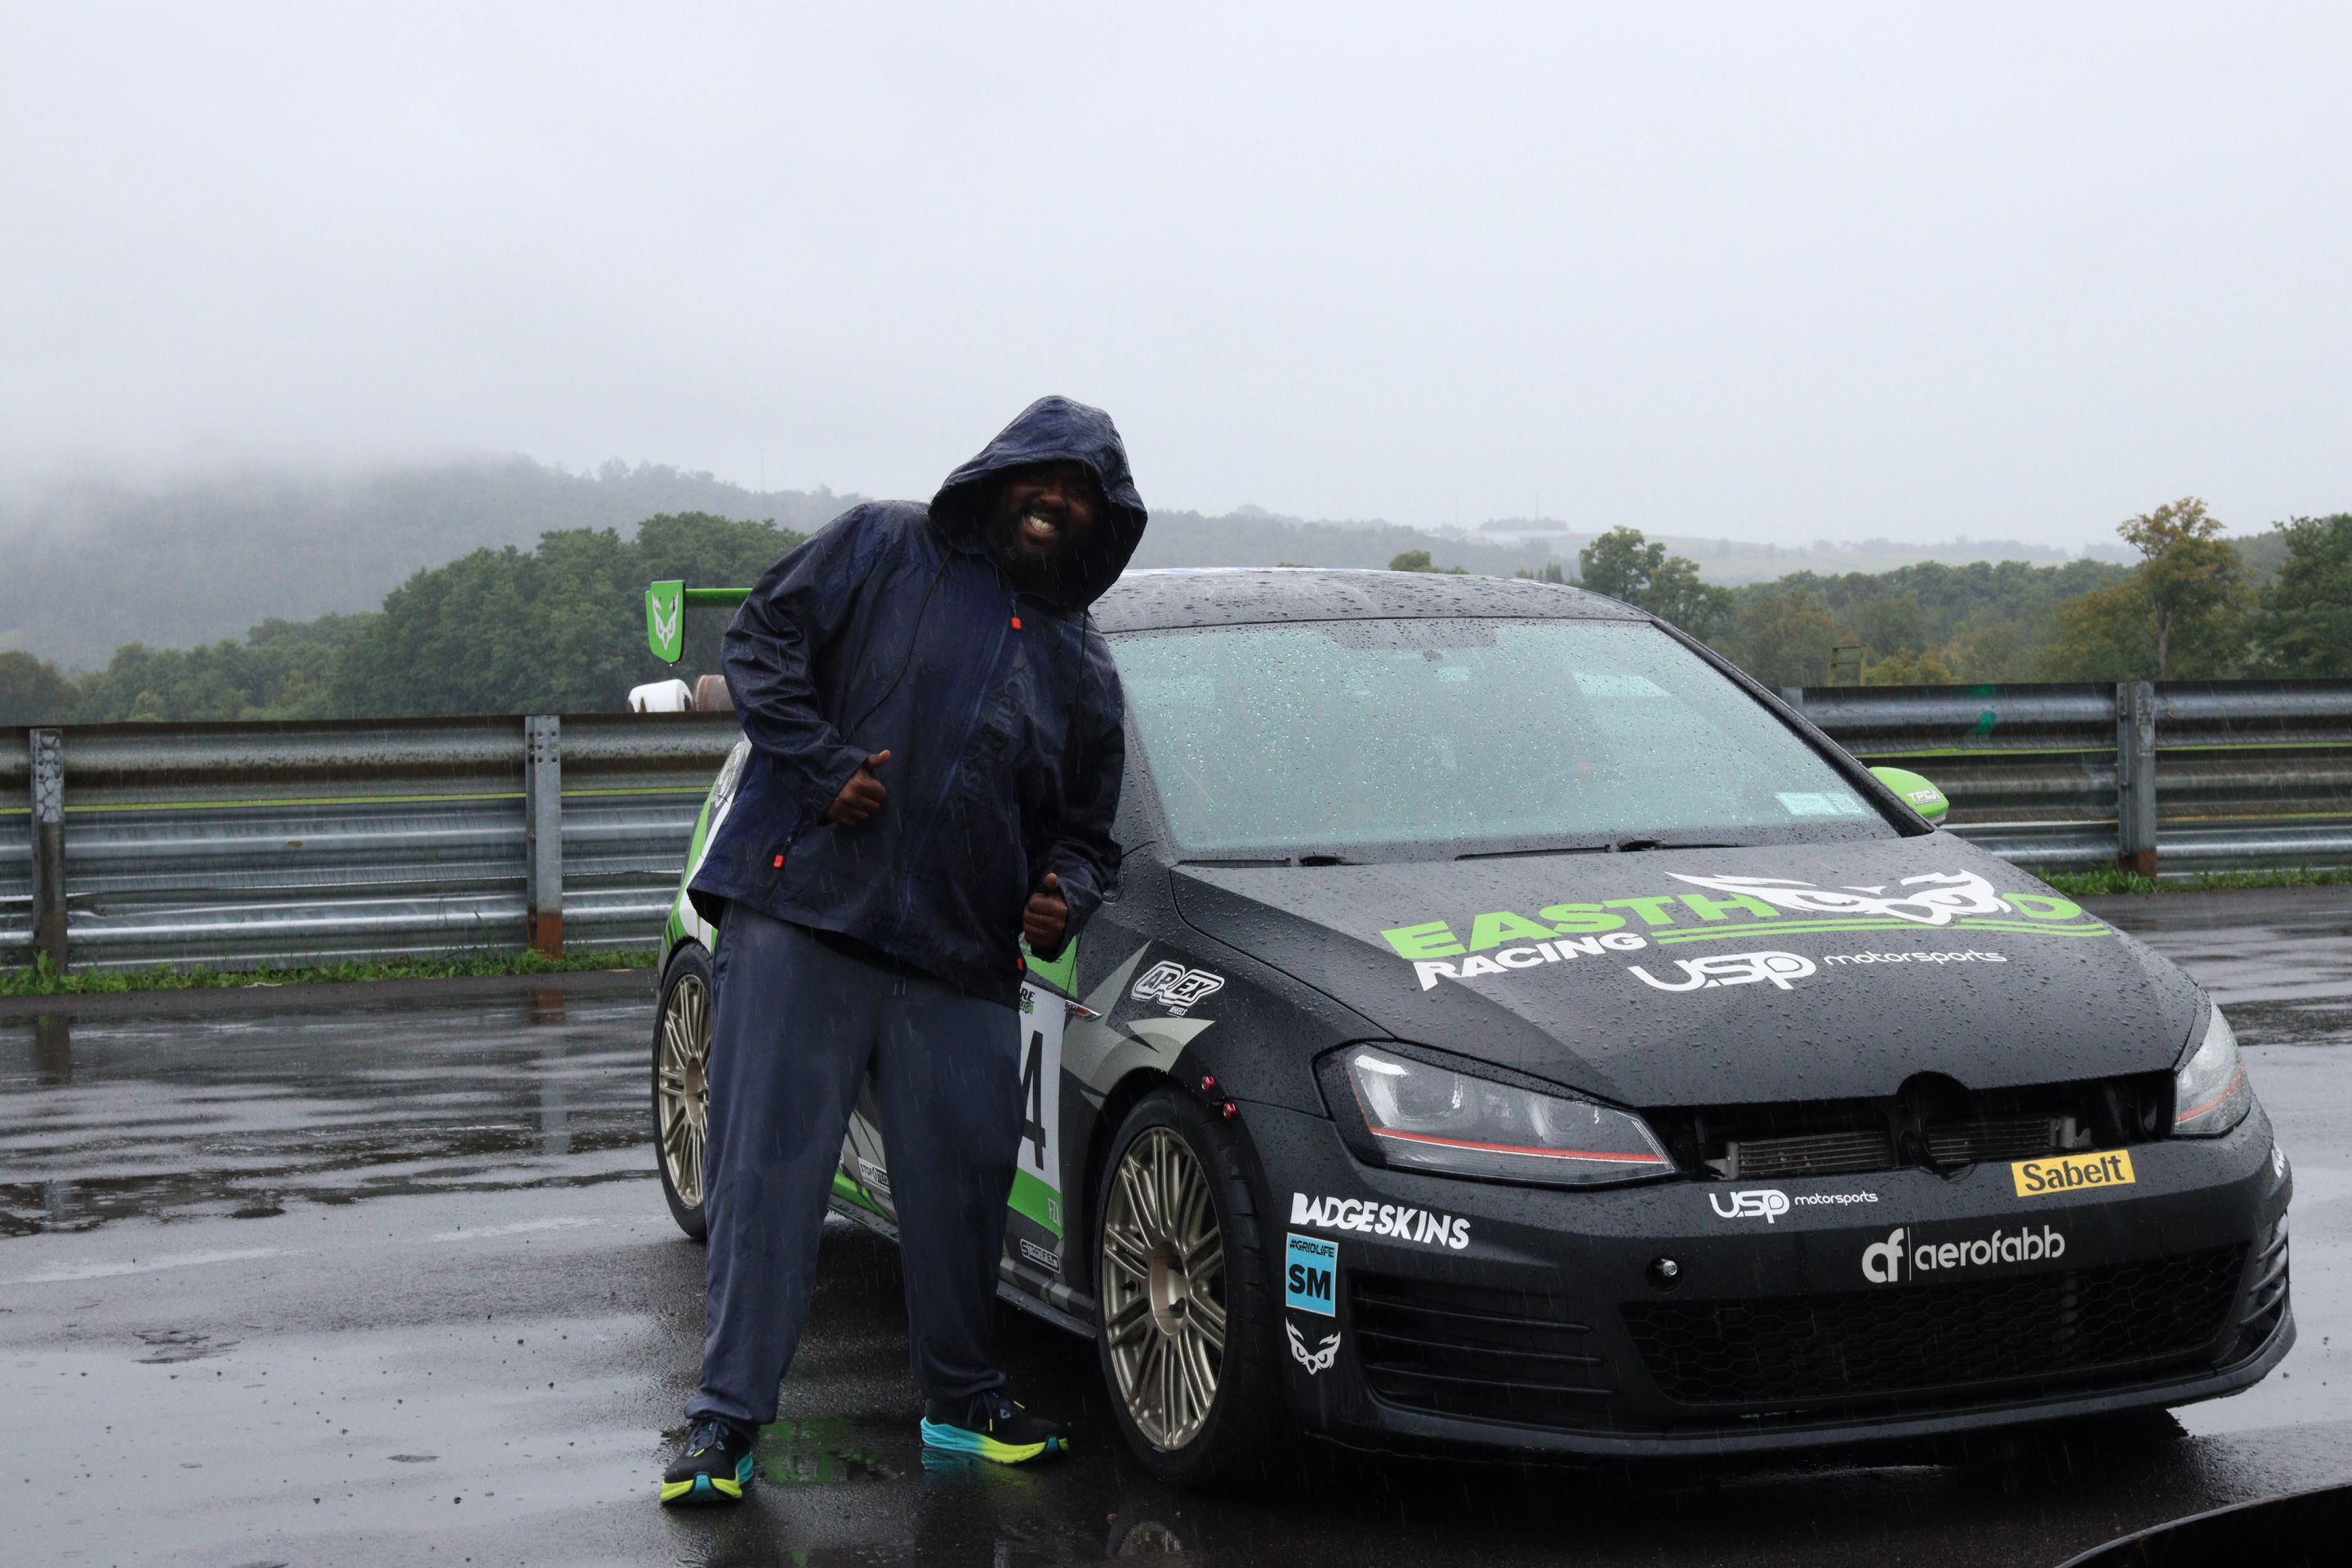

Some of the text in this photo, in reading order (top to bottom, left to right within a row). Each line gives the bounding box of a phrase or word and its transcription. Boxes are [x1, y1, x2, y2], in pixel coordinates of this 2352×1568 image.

[1413, 933, 1648, 991] RACING
[1823, 949, 2007, 964] motorsports
[1138, 968, 1215, 1000] APEX
[2022, 1155, 2126, 1192] Sabelt
[1794, 1191, 1878, 1206] motorsports
[1290, 1192, 1471, 1250] BADGESKINS
[1290, 1238, 1334, 1258] #GRIDLIFE
[1914, 1225, 2065, 1271] aerofabb
[1289, 1263, 1331, 1301] SM
